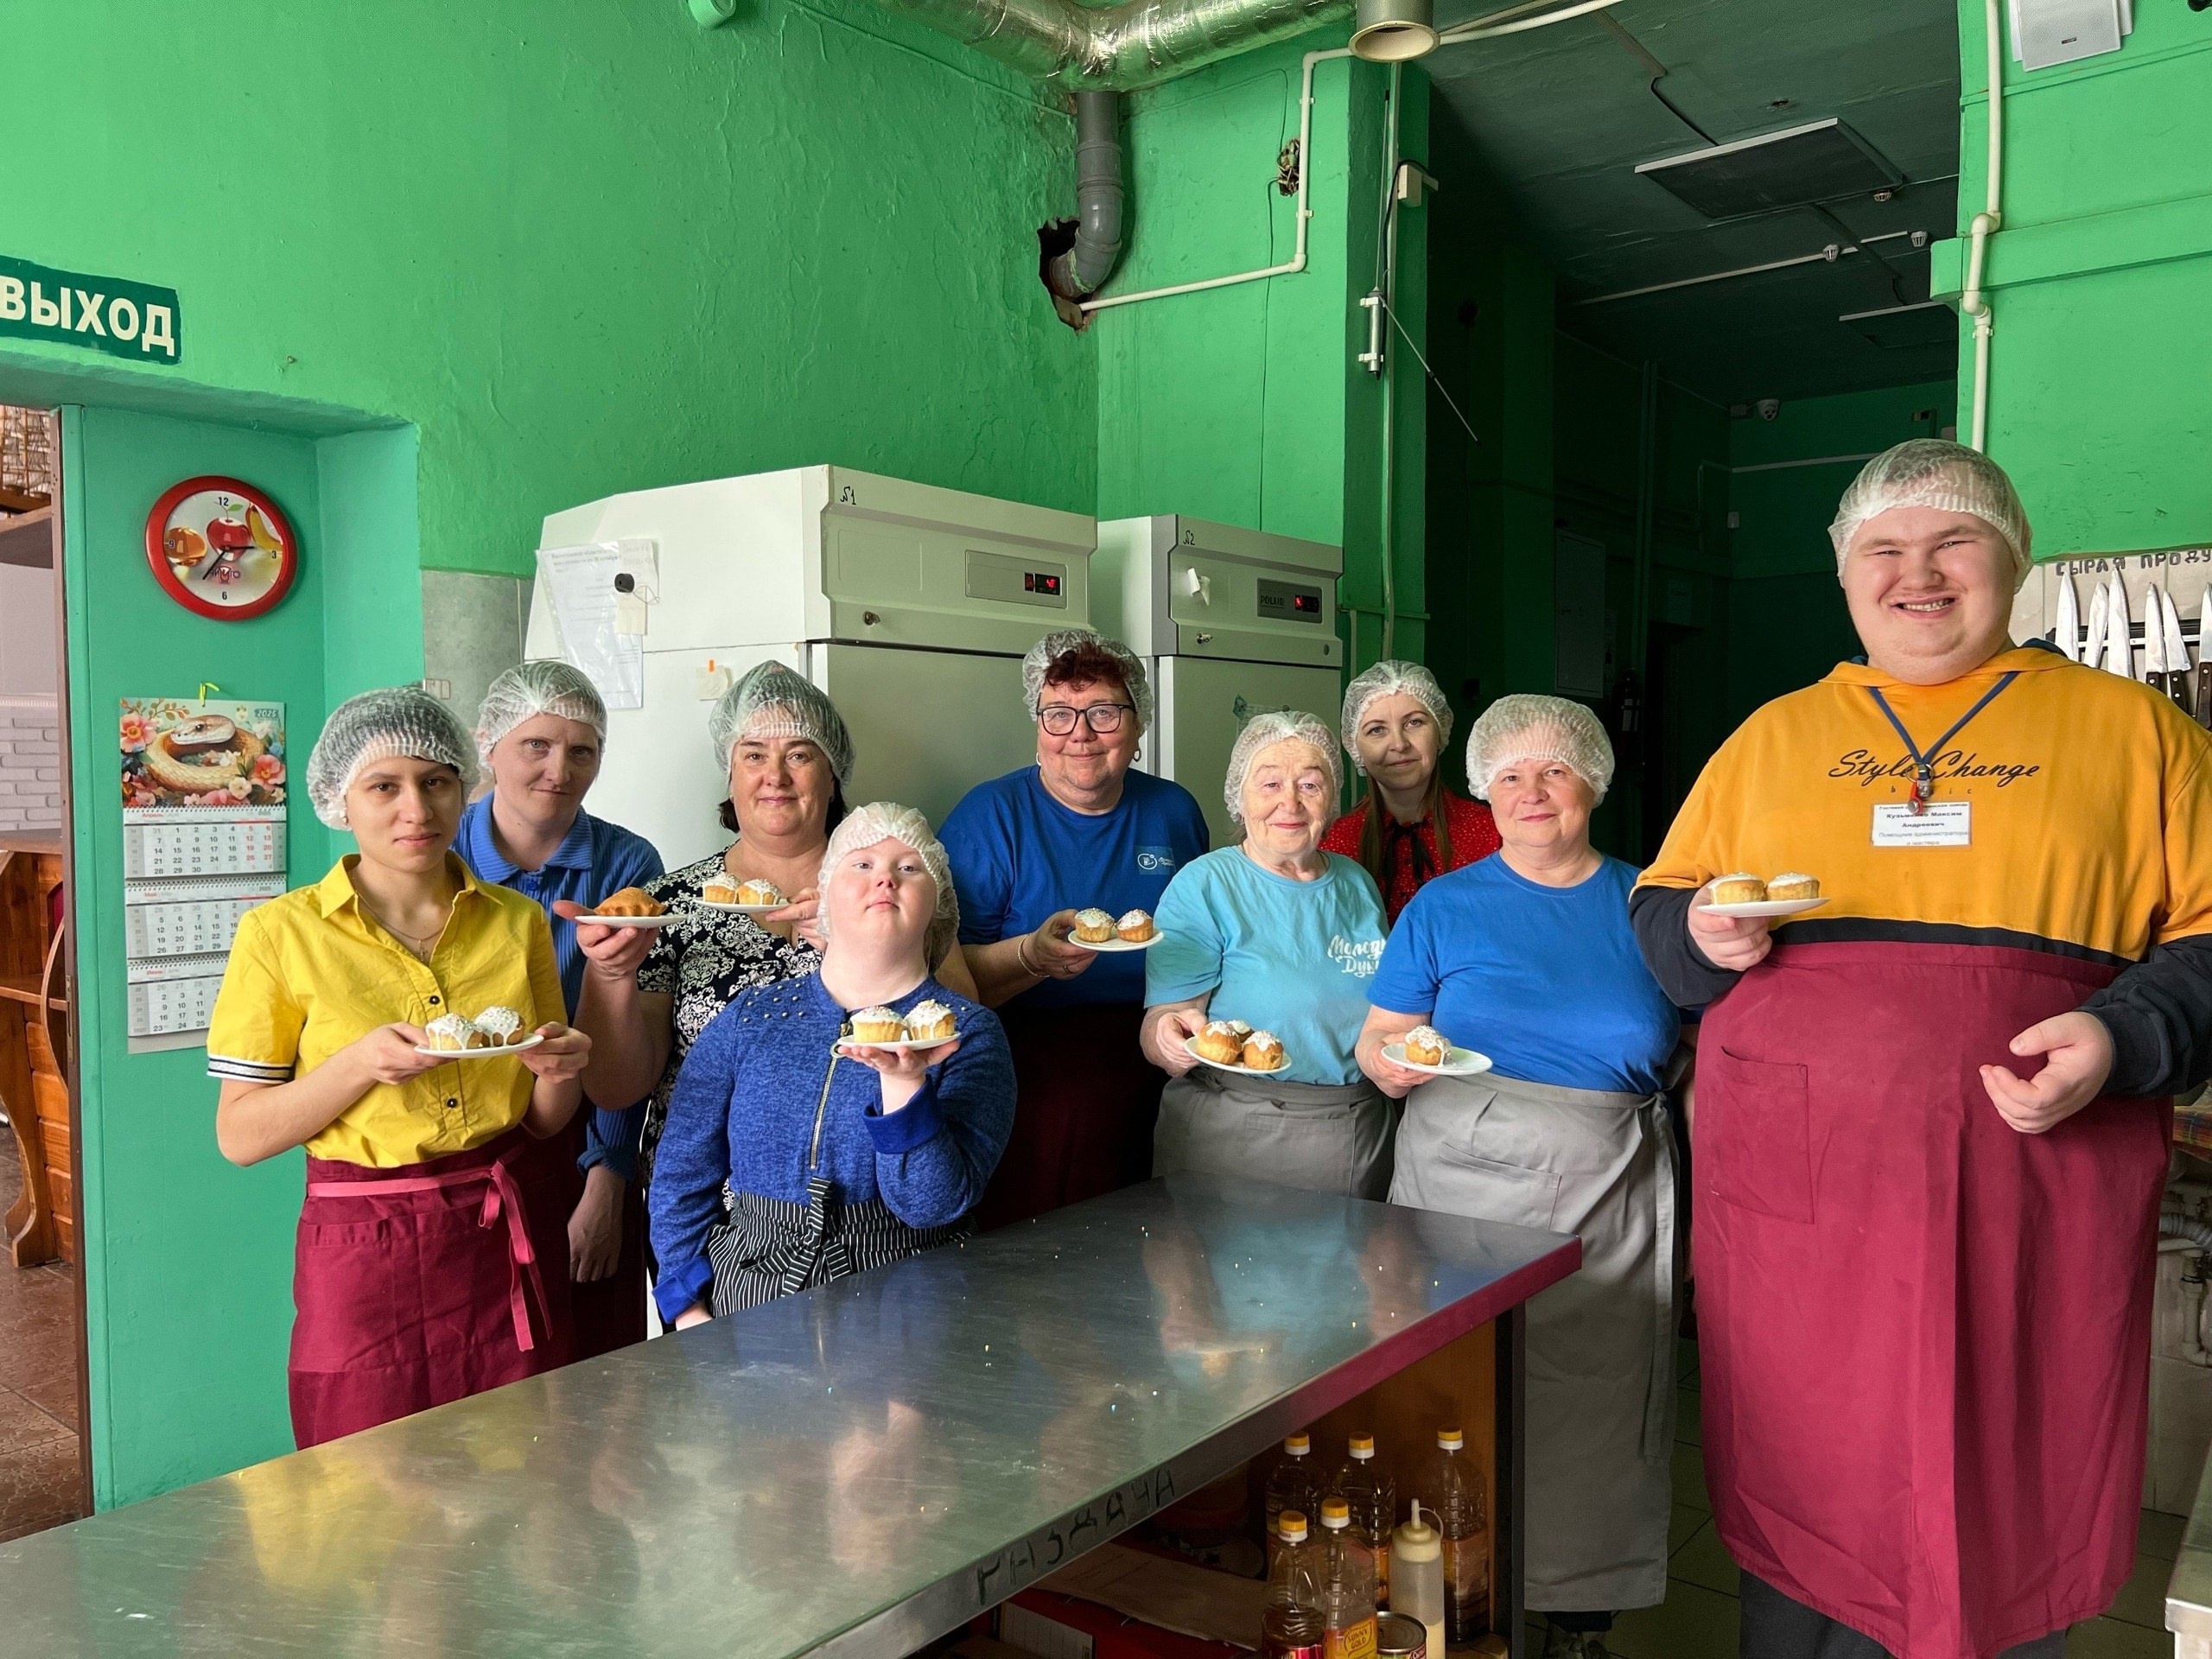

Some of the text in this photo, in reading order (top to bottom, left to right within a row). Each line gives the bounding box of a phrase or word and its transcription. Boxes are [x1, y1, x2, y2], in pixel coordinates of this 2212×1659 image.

[0, 276, 175, 356] ВЫХОД
[218, 497, 229, 506] 12
[168, 539, 276, 560] 9 3
[2056, 557, 2126, 576] СЫРАЯ
[221, 591, 228, 601] 6
[257, 709, 276, 718] 2025
[1828, 749, 2040, 788] Style Change
[1348, 1630, 1368, 1642] SUNNY
[1351, 1637, 1367, 1649] GOLD
